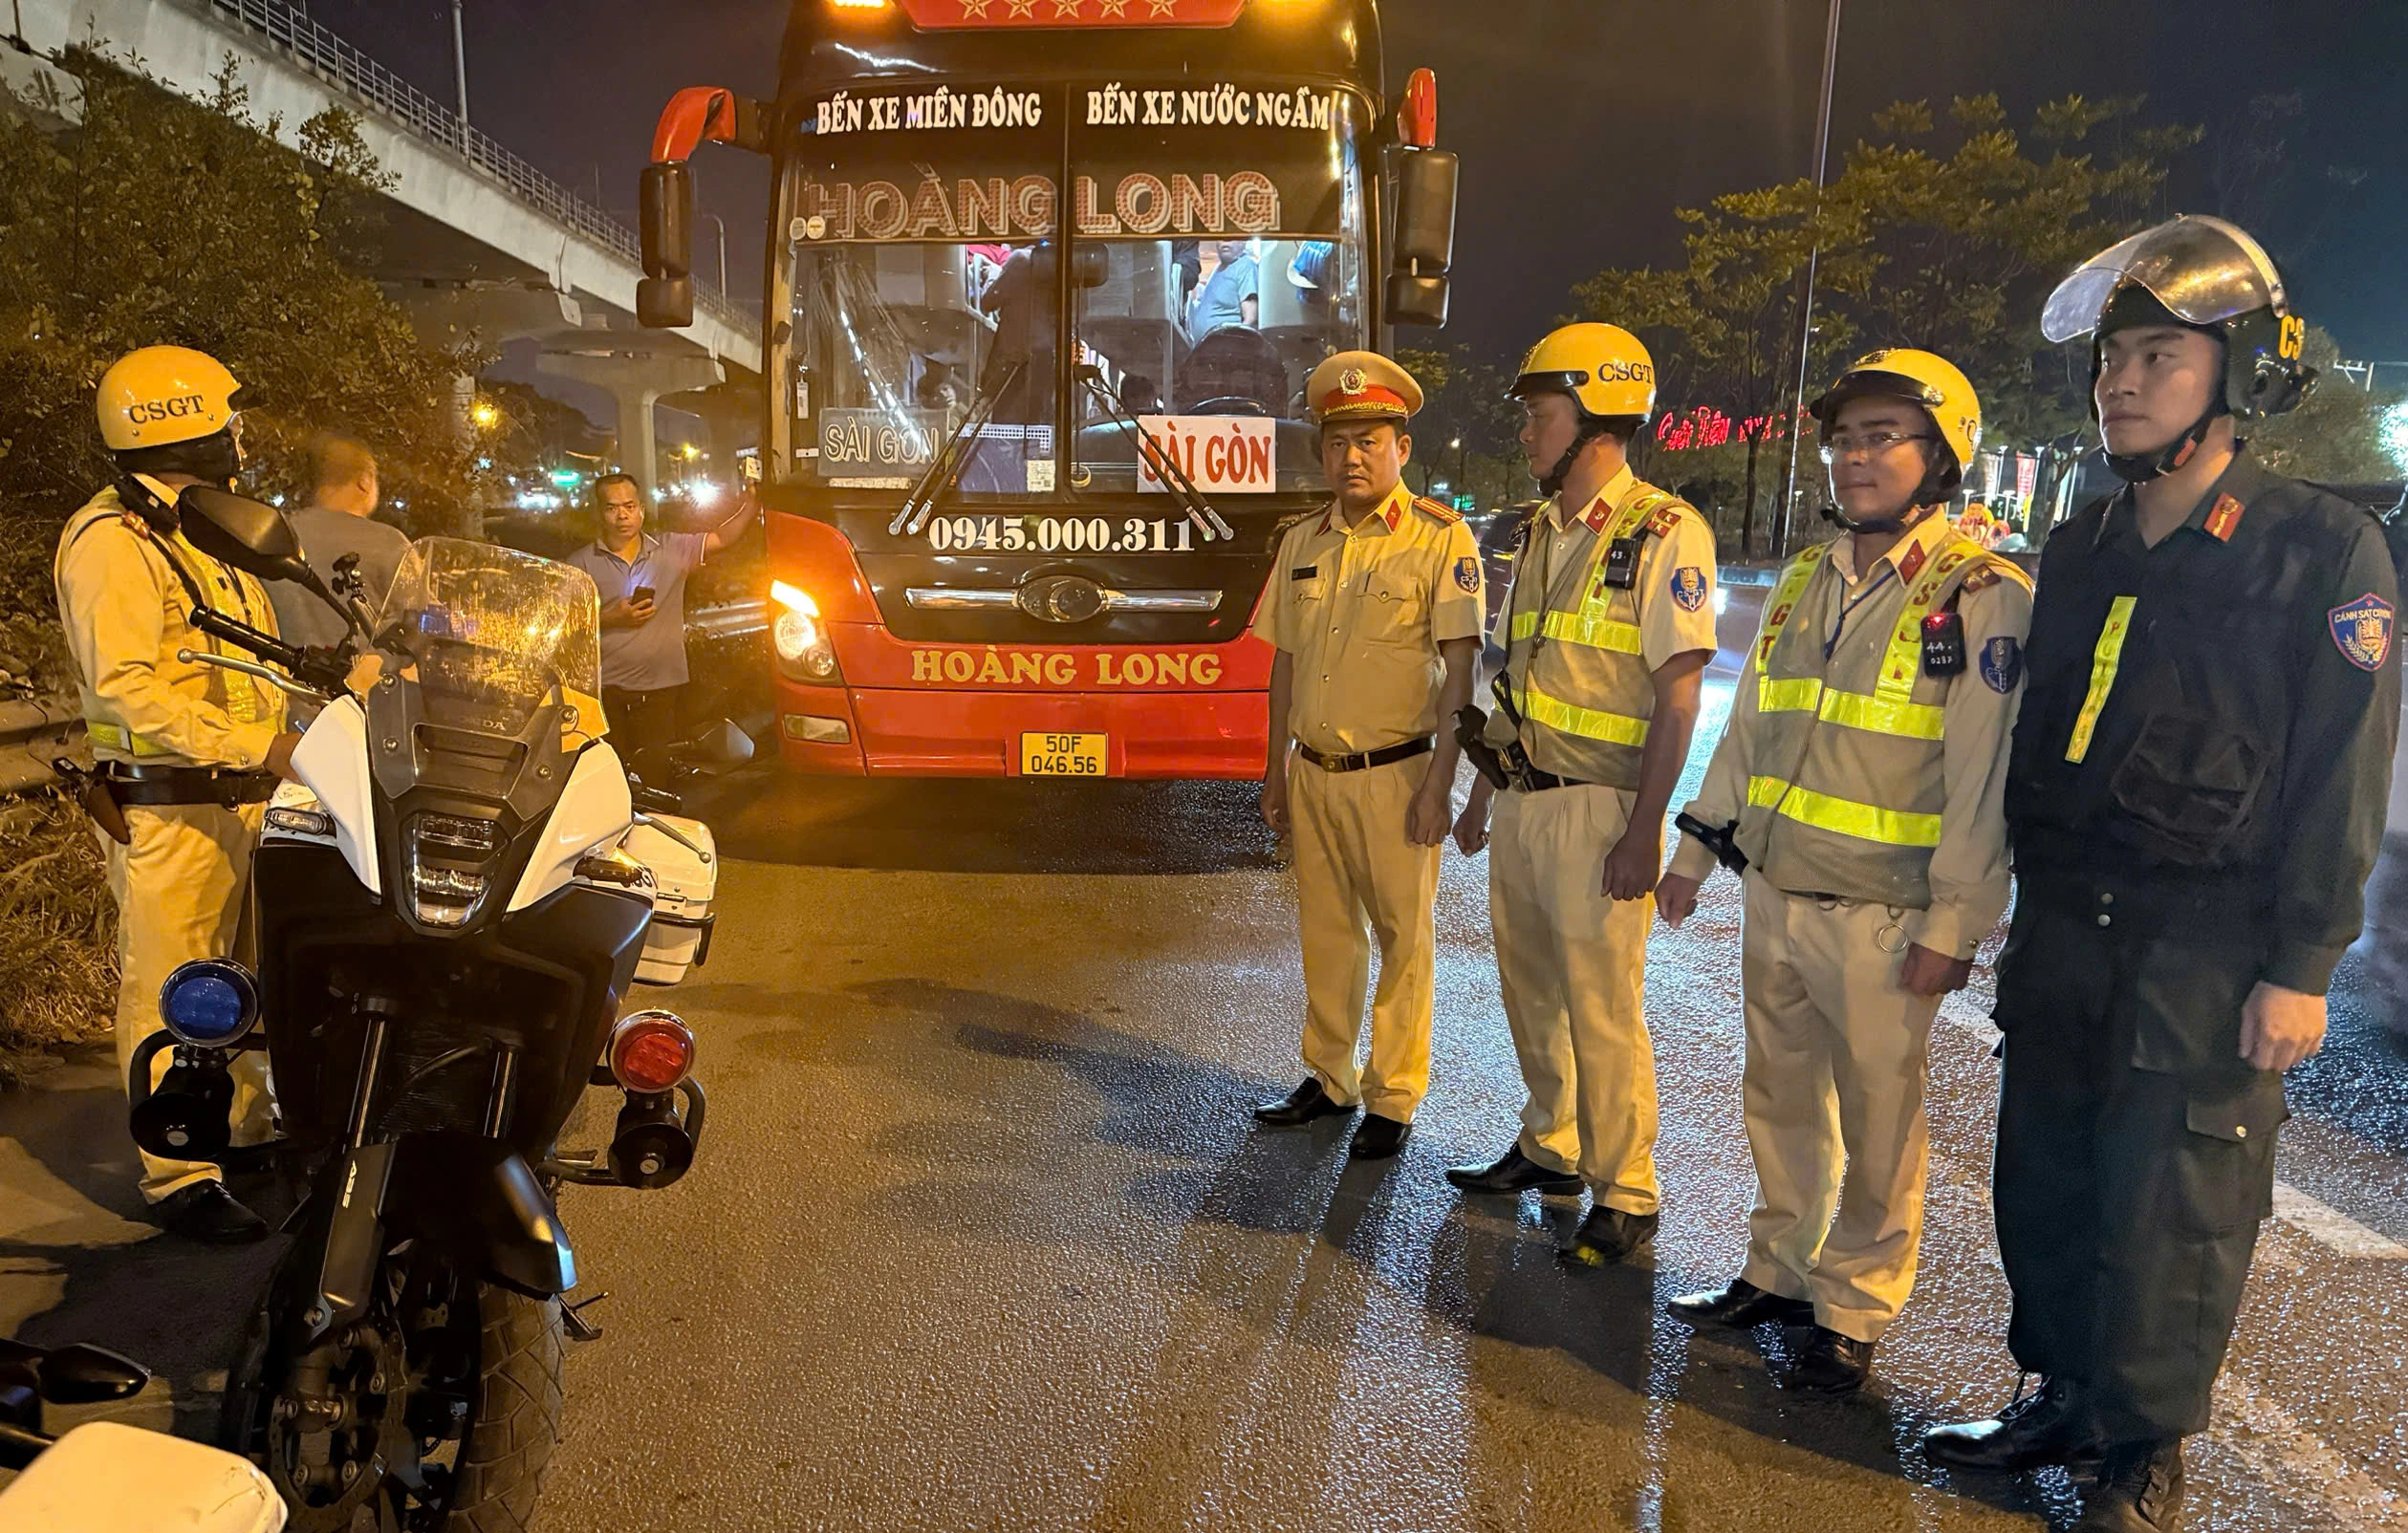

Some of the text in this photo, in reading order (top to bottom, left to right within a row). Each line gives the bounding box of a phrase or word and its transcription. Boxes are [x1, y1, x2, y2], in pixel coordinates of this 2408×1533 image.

[816, 84, 1042, 135] BẾN XE MIỀN ĐÔNG
[1086, 81, 1330, 131] BẾN XE NƯỚC NGẦM
[808, 161, 1280, 239] HOÀNG LONG
[1598, 362, 1653, 384] CSGT
[129, 394, 204, 424] CSGT
[825, 416, 871, 463] SÀI
[1144, 421, 1270, 484] SÀI GÒN
[928, 516, 1195, 551] 0945.000.311
[911, 644, 1223, 685] HOÀNG LONG
[1031, 756, 1097, 773] 046.56
[1046, 736, 1082, 753] 50F
